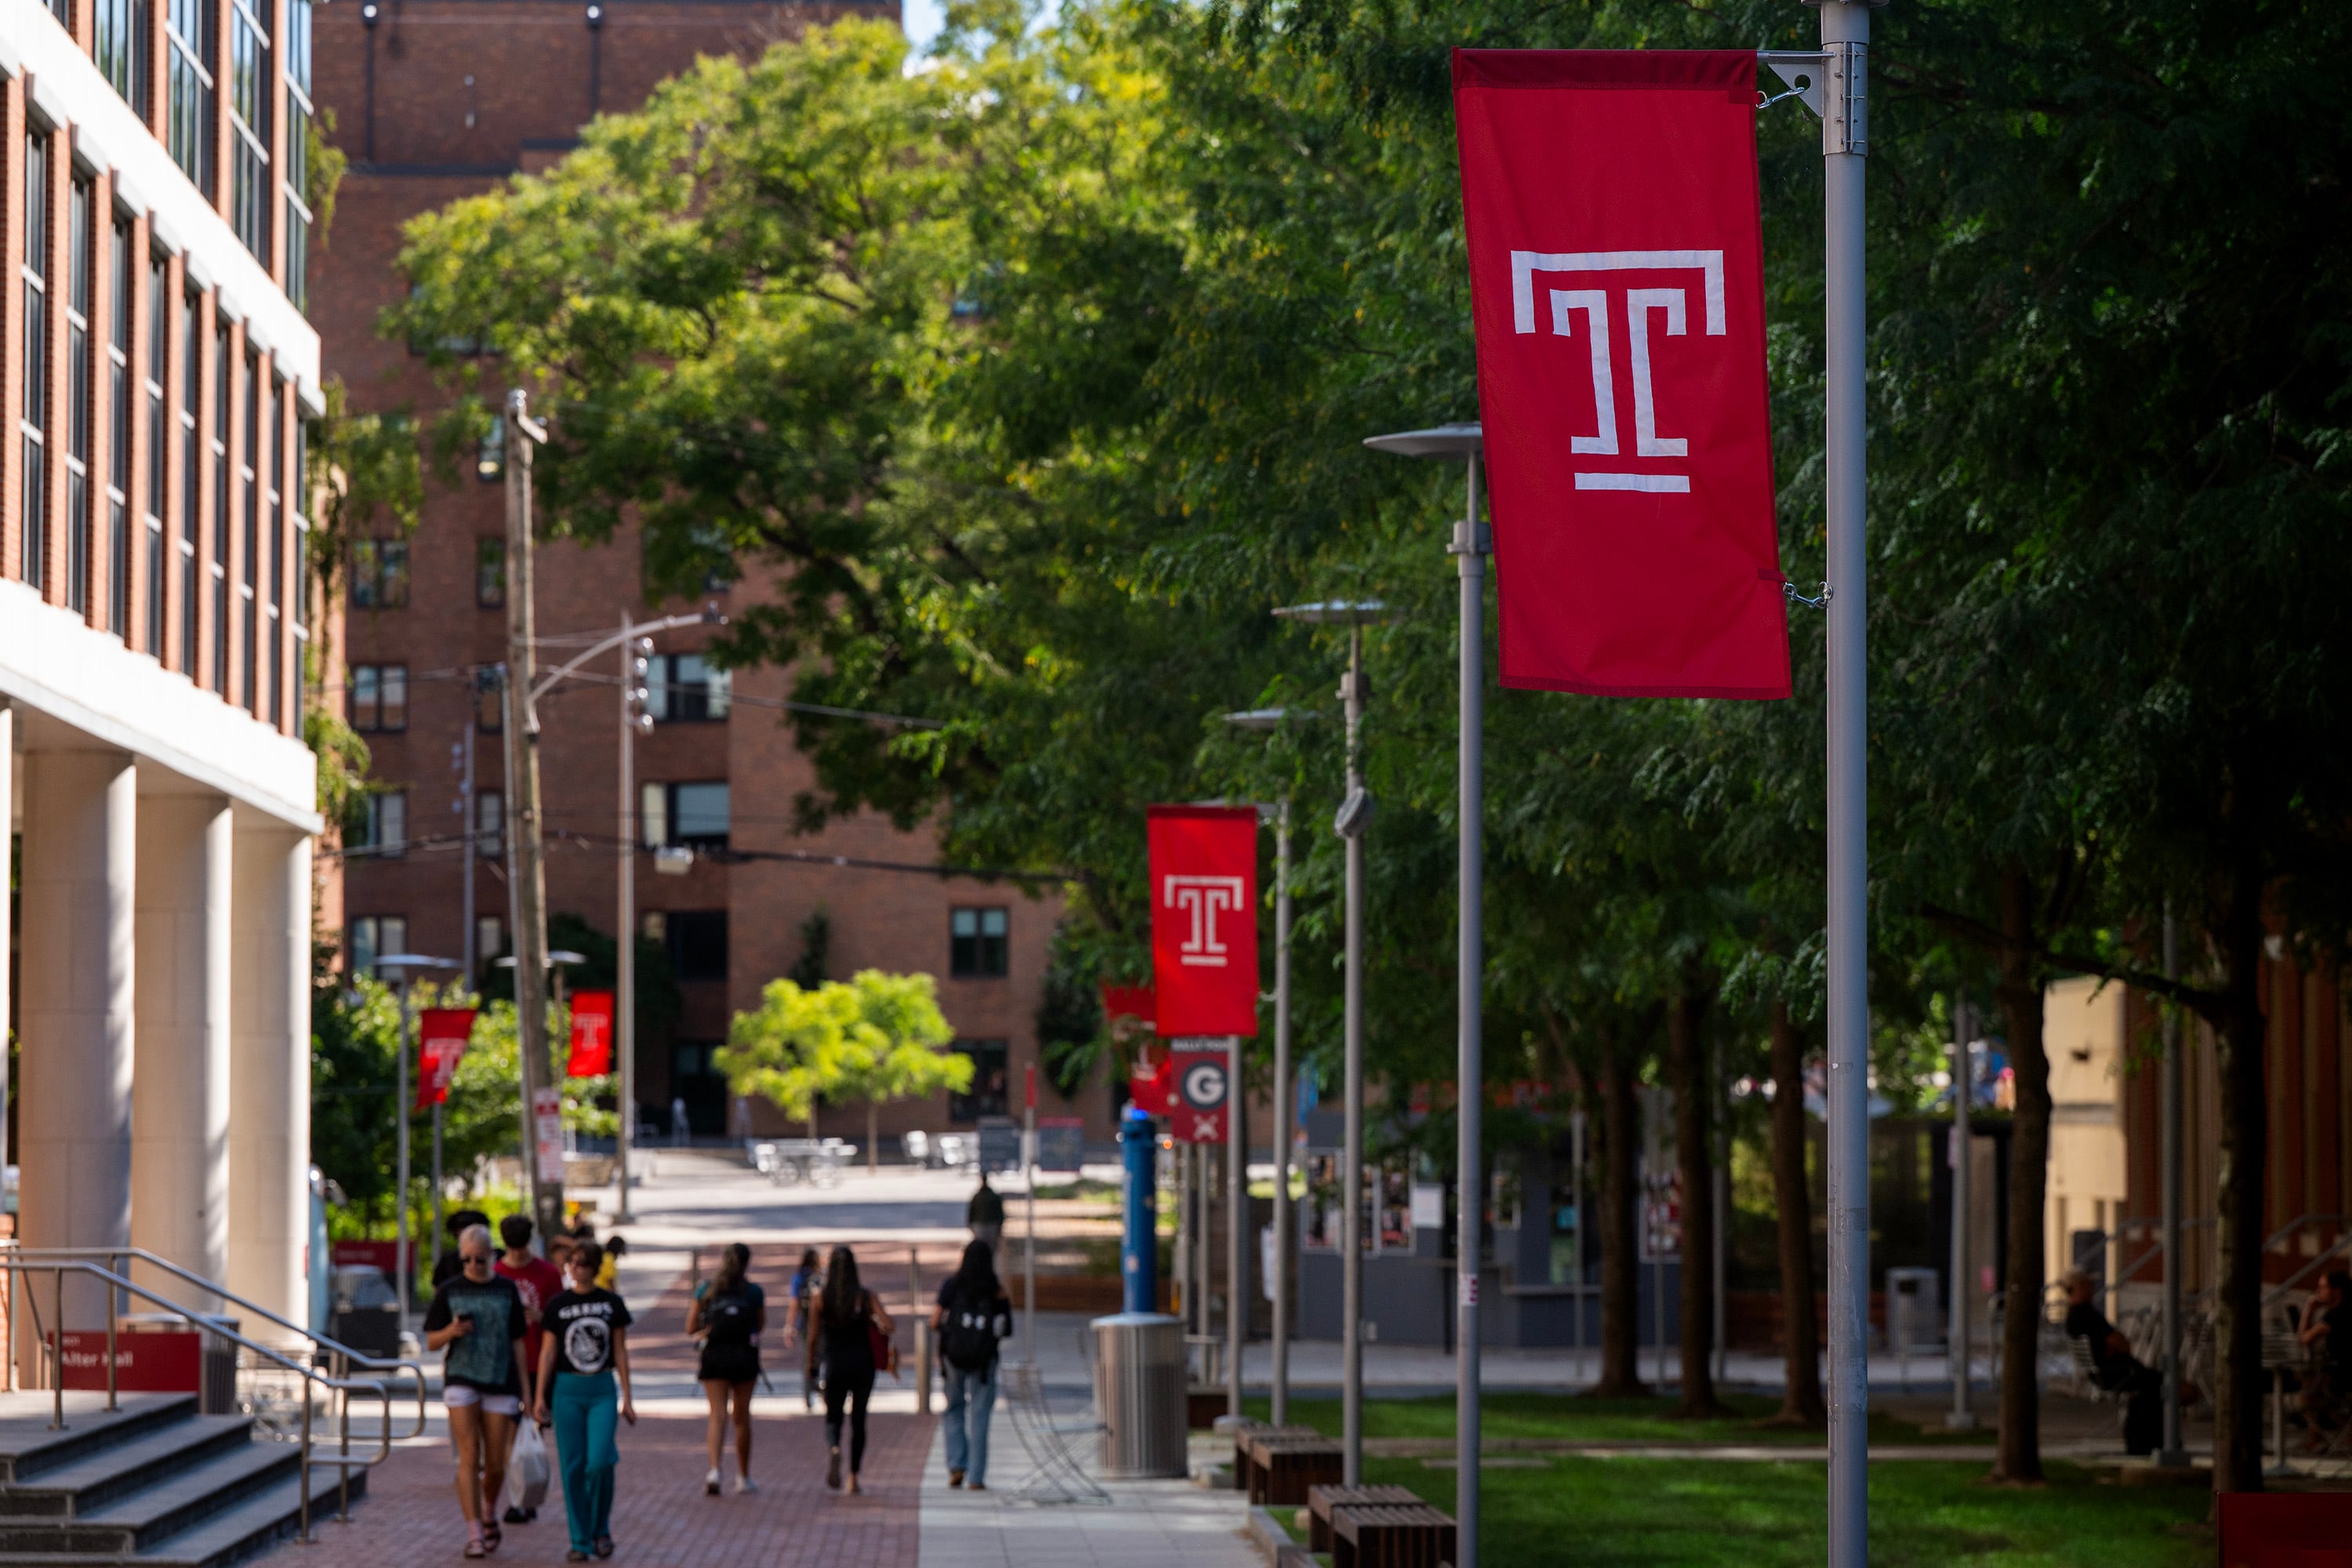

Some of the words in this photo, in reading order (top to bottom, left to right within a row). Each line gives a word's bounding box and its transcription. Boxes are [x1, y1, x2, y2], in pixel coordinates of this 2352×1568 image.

[1511, 249, 1726, 494] T
[1163, 874, 1244, 967] T
[575, 1013, 609, 1050] T
[424, 1036, 467, 1088] T
[1186, 1065, 1225, 1105] G
[61, 1350, 100, 1367] Alter
